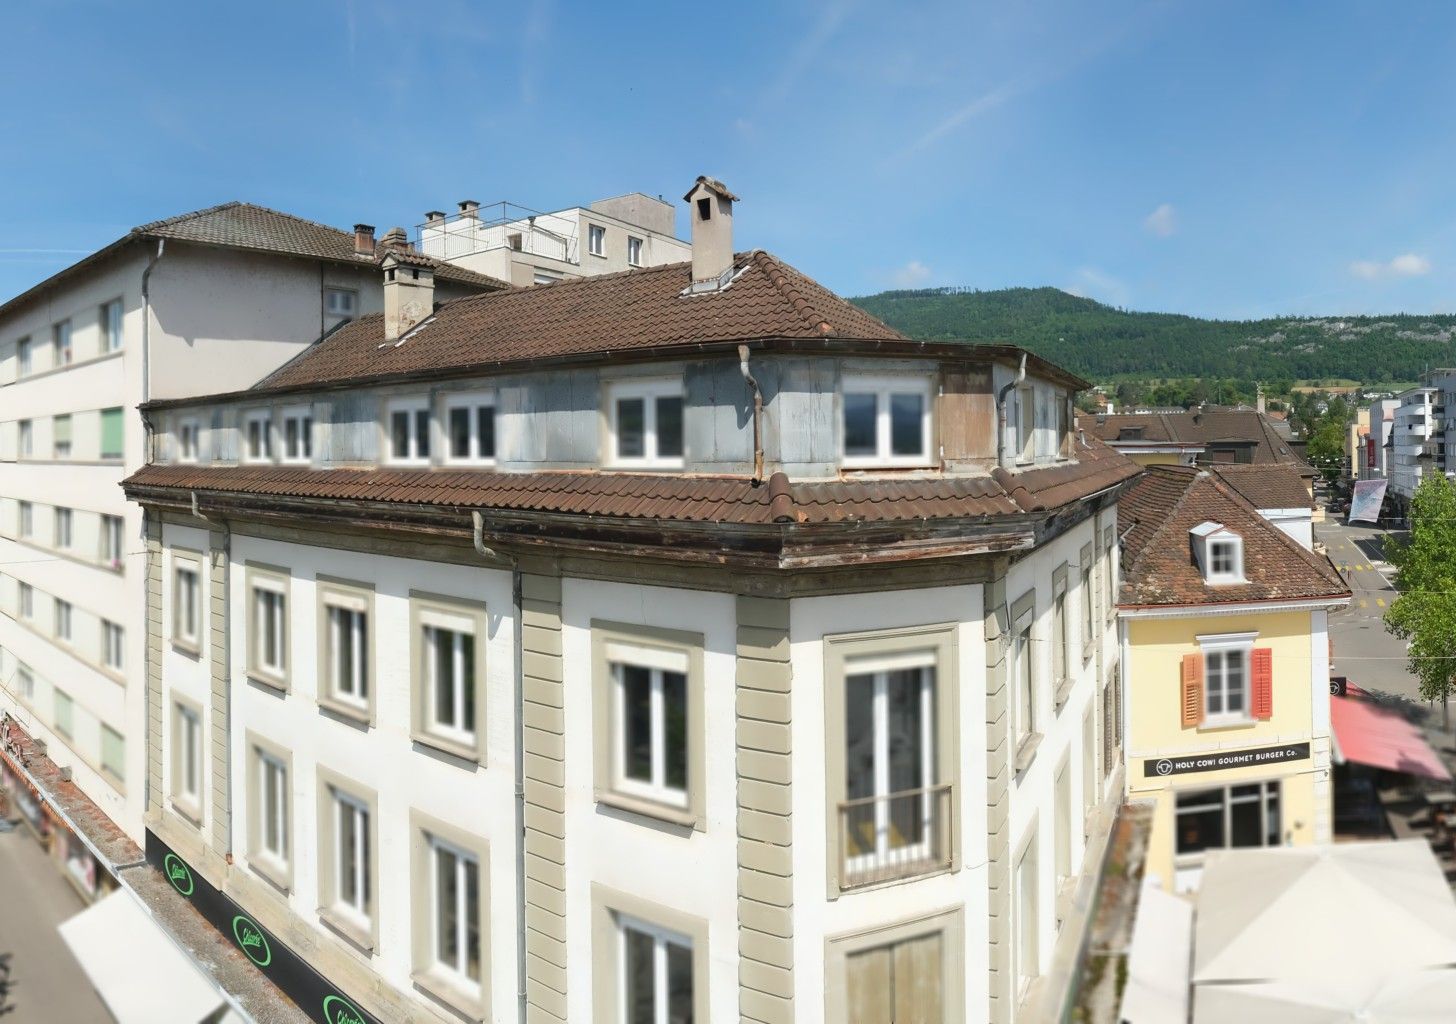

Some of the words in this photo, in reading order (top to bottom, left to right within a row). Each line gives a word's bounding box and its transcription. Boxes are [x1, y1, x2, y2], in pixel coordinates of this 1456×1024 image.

[1175, 761, 1195, 769] HOLY
[1218, 754, 1253, 765] GOURMET
[1255, 751, 1284, 760] BURGER
